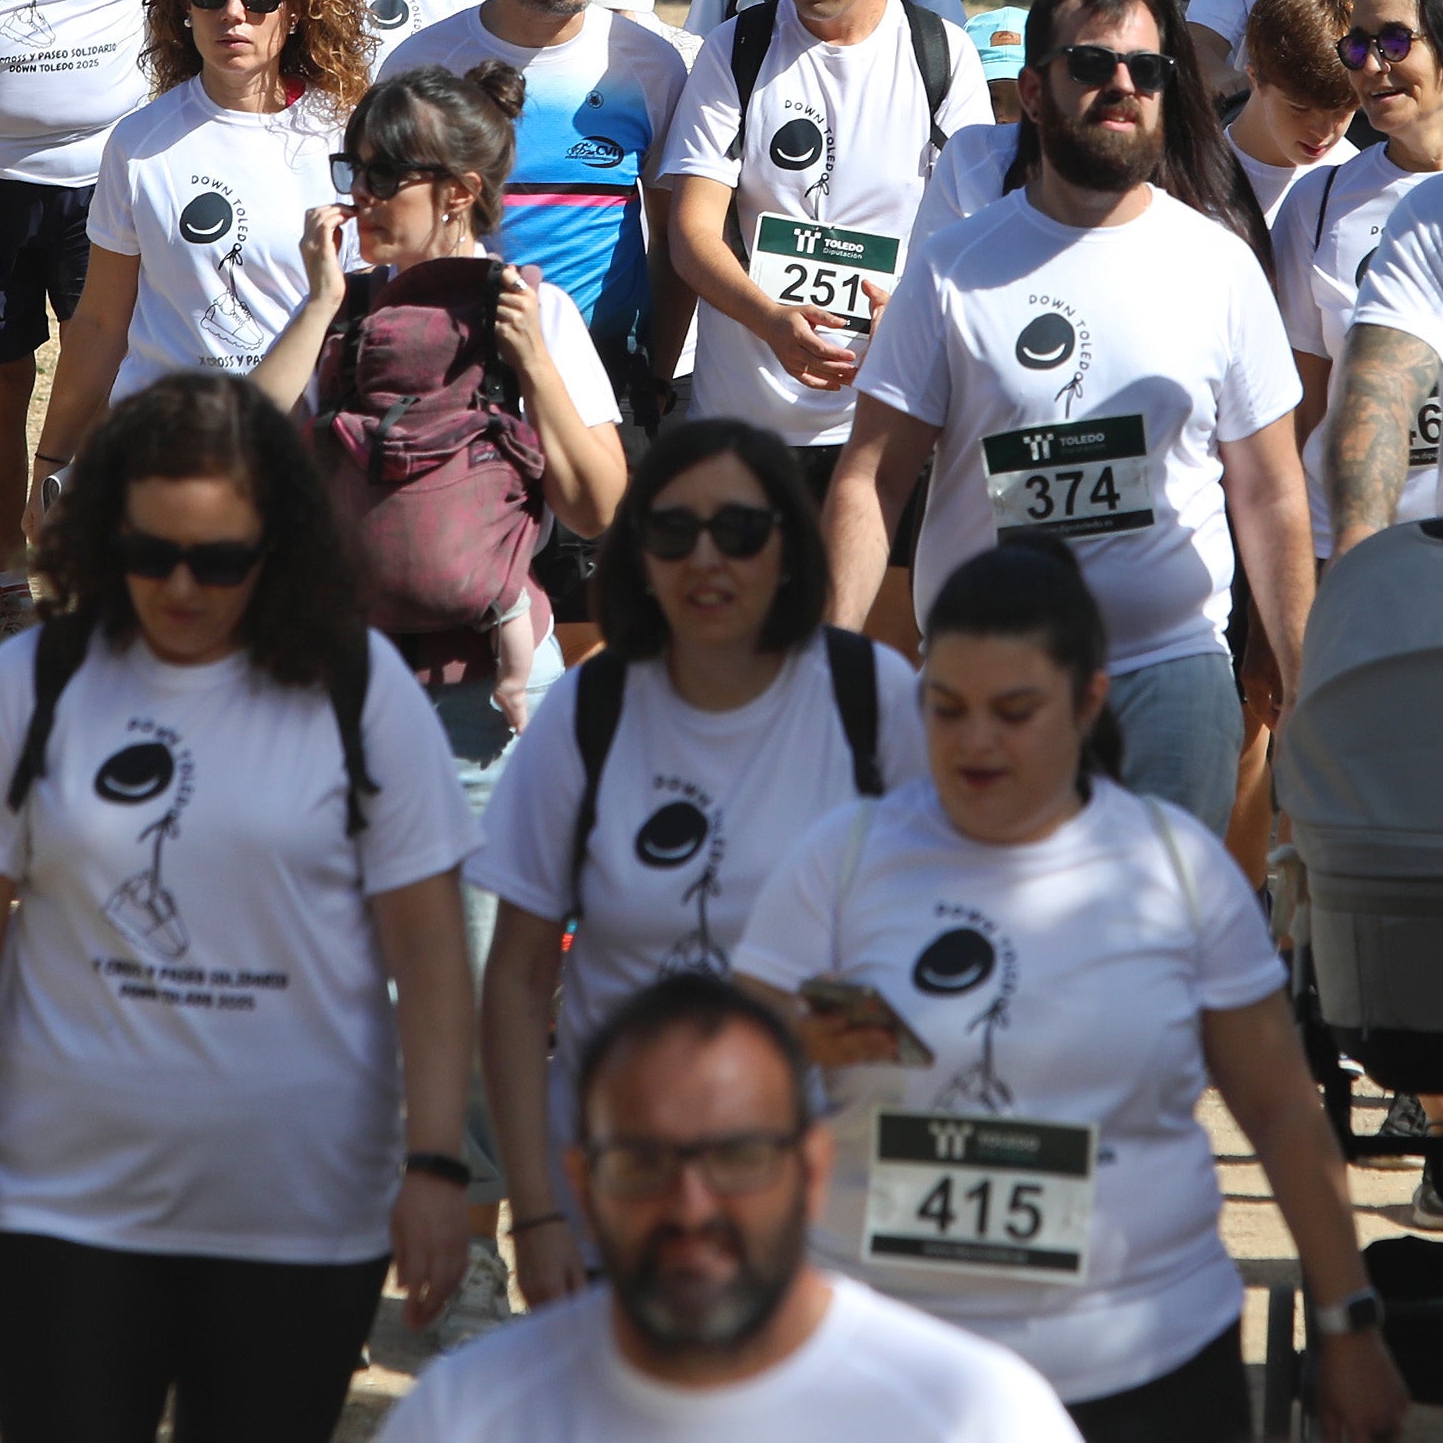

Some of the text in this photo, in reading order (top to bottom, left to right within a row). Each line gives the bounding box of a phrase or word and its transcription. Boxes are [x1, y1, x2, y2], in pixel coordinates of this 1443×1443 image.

[9, 58, 100, 74] DOWN TOLEDO 2025
[37, 50, 68, 62] PASEO
[71, 43, 117, 59] SOLIDARIO
[785, 100, 836, 180] DOWN TOLEDO
[191, 175, 247, 252] DOWN TOLEDO
[824, 238, 865, 254] TOLEDO
[779, 264, 861, 312] 251
[1029, 295, 1093, 380] DOWN TOLEDO
[1059, 433, 1105, 447] TOLEDO
[1024, 466, 1120, 519] 374
[917, 1176, 1043, 1241] 415
